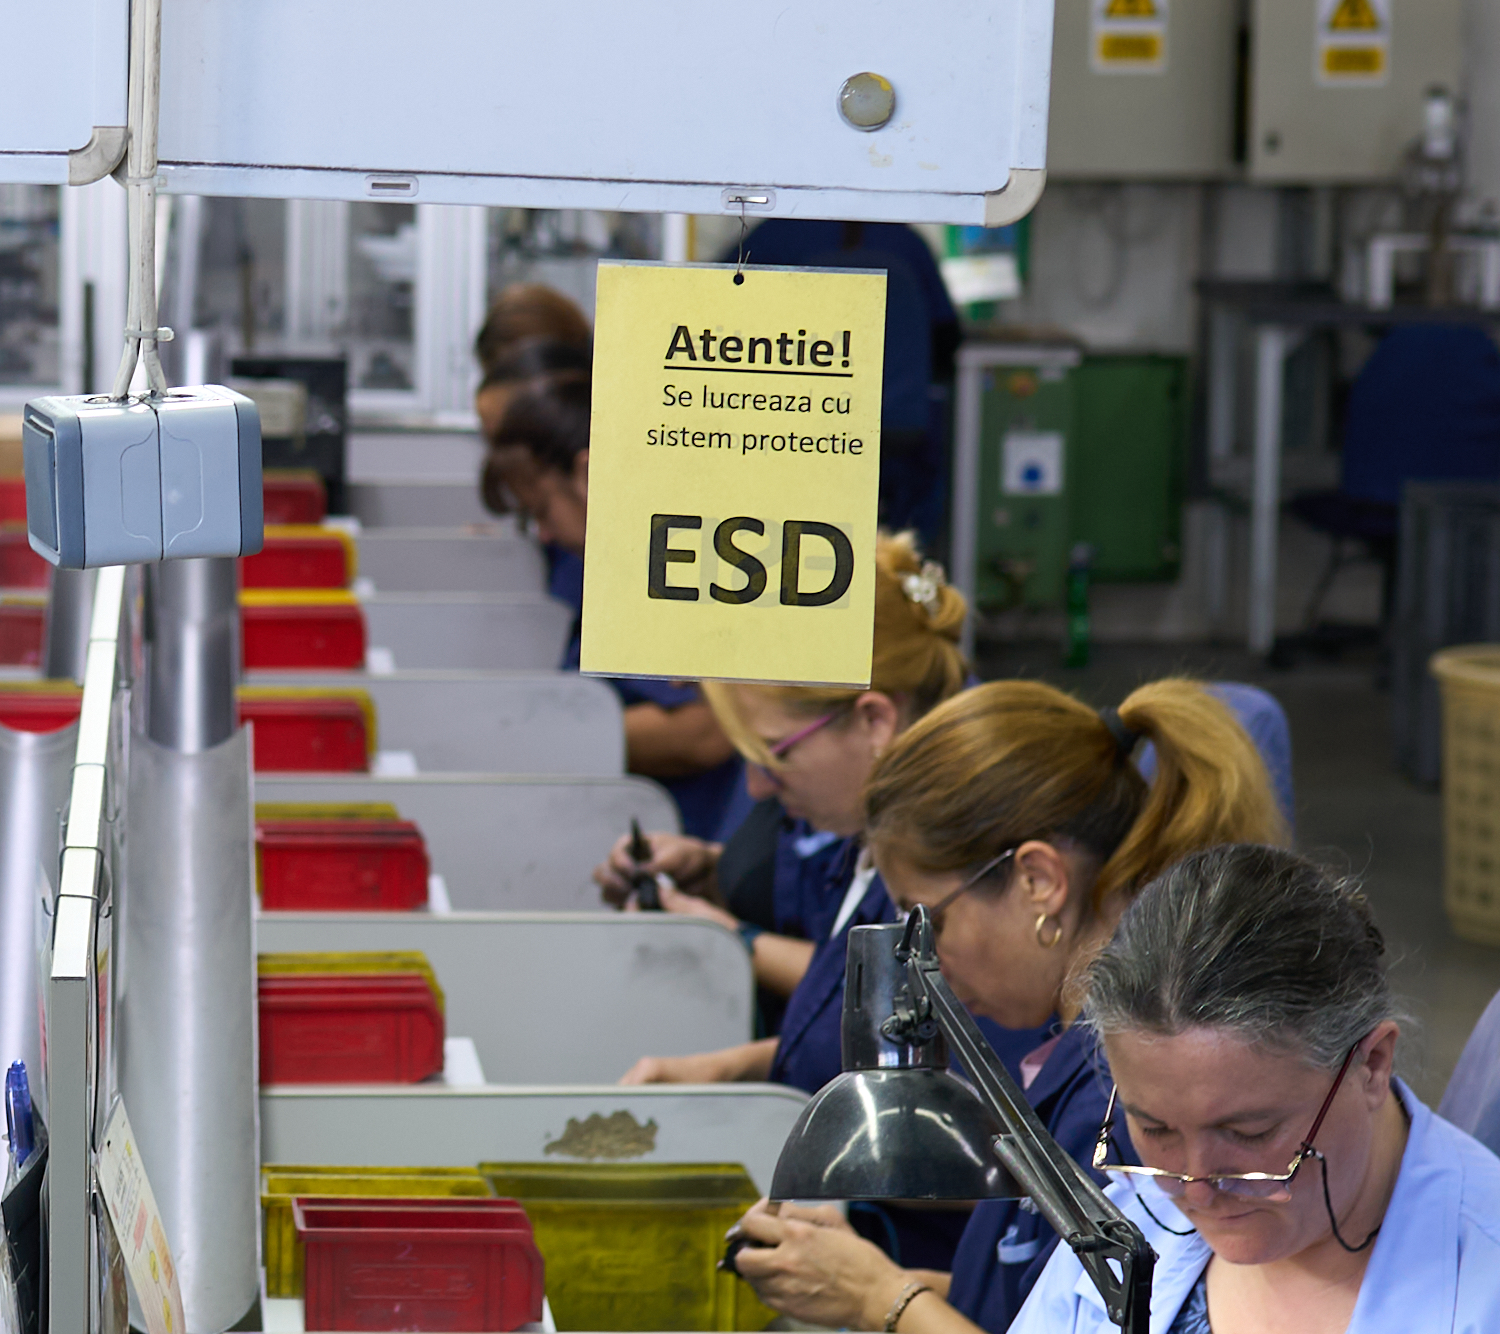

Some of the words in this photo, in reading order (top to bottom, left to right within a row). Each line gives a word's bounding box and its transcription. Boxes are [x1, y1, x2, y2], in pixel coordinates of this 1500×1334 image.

[664, 325, 852, 369] Atentie!
[661, 384, 693, 408] Se
[702, 385, 812, 414] lucreaza
[820, 394, 852, 415] cu
[646, 424, 732, 450] sistem
[742, 432, 864, 456] protectie
[647, 513, 855, 607] ESD
